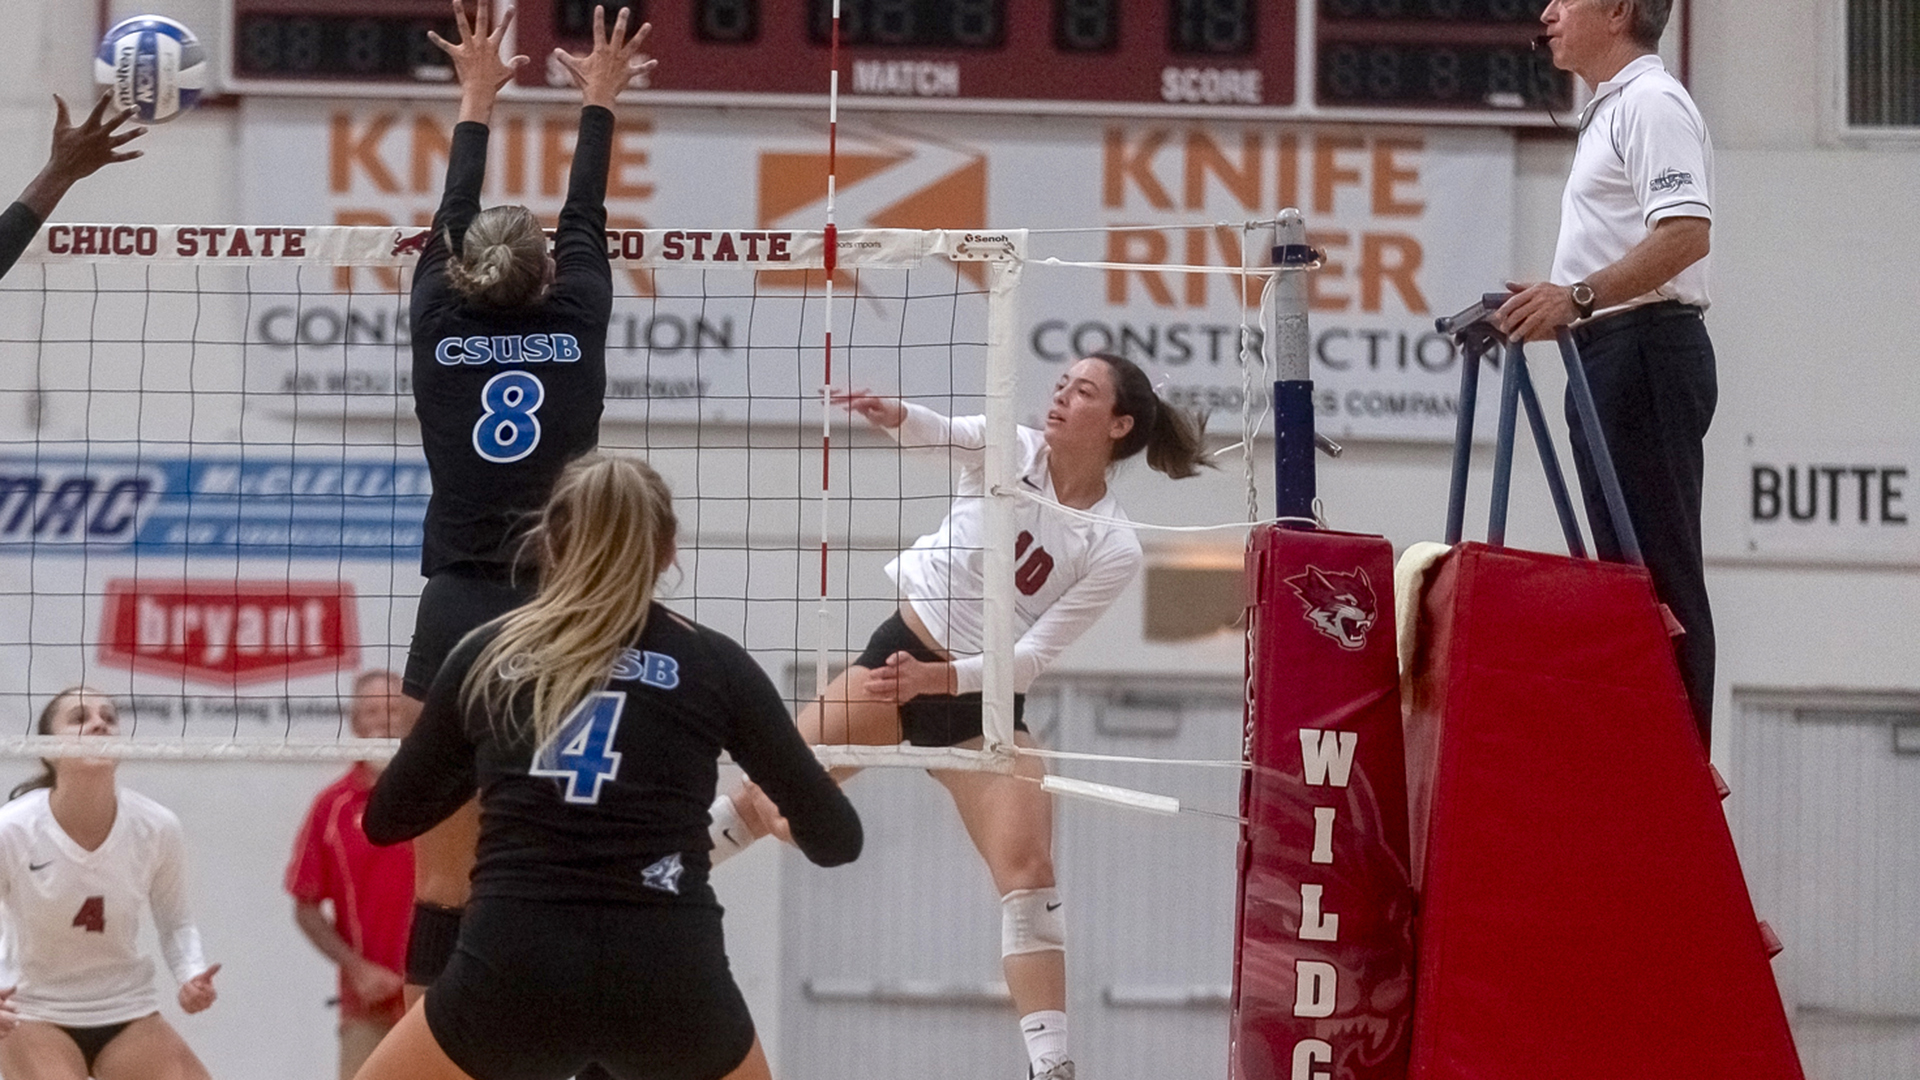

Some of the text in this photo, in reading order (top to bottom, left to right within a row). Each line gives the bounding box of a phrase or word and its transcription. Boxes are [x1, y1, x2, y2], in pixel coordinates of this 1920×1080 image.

[852, 61, 960, 97] MATCH
[1161, 66, 1263, 104] SCORE
[1102, 126, 1426, 218] KNIFE
[47, 226, 307, 258] CHICO STATE
[662, 231, 792, 262] STATE
[974, 234, 1009, 243] Senoh
[1105, 224, 1431, 316] RIVER
[434, 333, 582, 367] CSUSB
[1027, 318, 1501, 374] CONSTRCTION
[471, 369, 545, 464] 8
[1750, 464, 1908, 526] BUTTE
[137, 595, 326, 664] bryant
[528, 690, 628, 805] 4
[72, 895, 105, 933] 4
